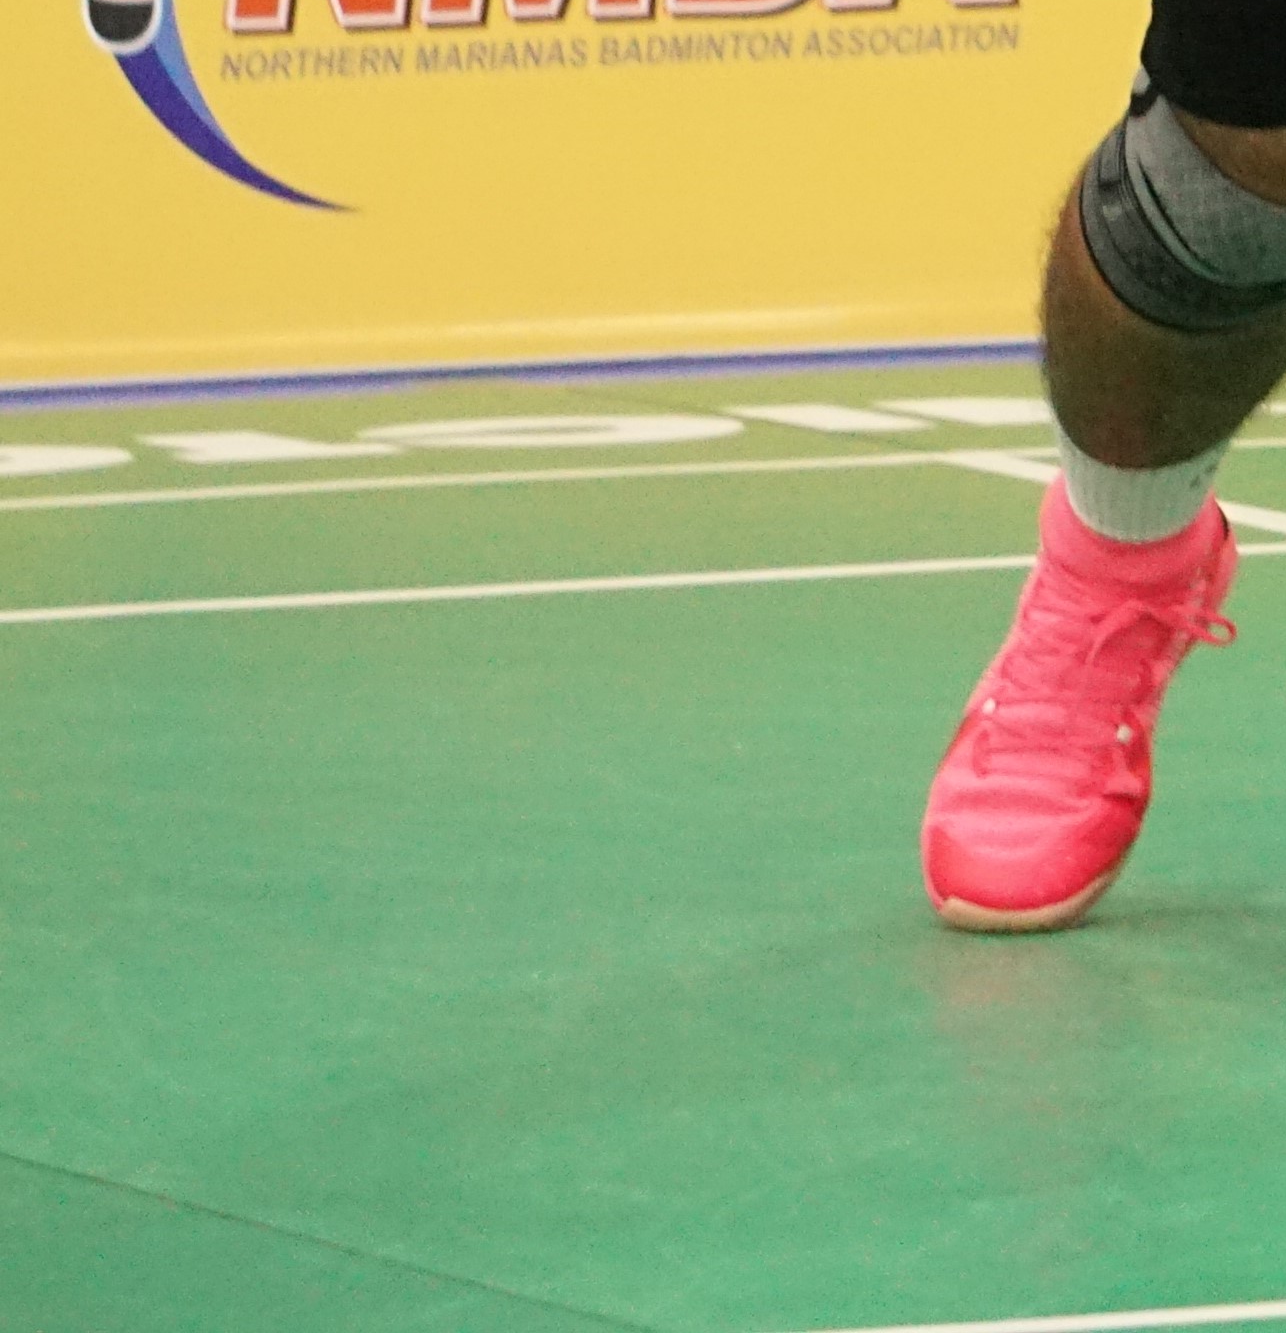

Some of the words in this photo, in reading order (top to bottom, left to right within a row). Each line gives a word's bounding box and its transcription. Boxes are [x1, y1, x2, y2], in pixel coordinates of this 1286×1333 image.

[220, 44, 404, 81] NORTHERN
[415, 38, 588, 74] MARIANAS
[599, 31, 792, 66] BADMINTON
[803, 22, 1019, 57] ASSOCIATION
